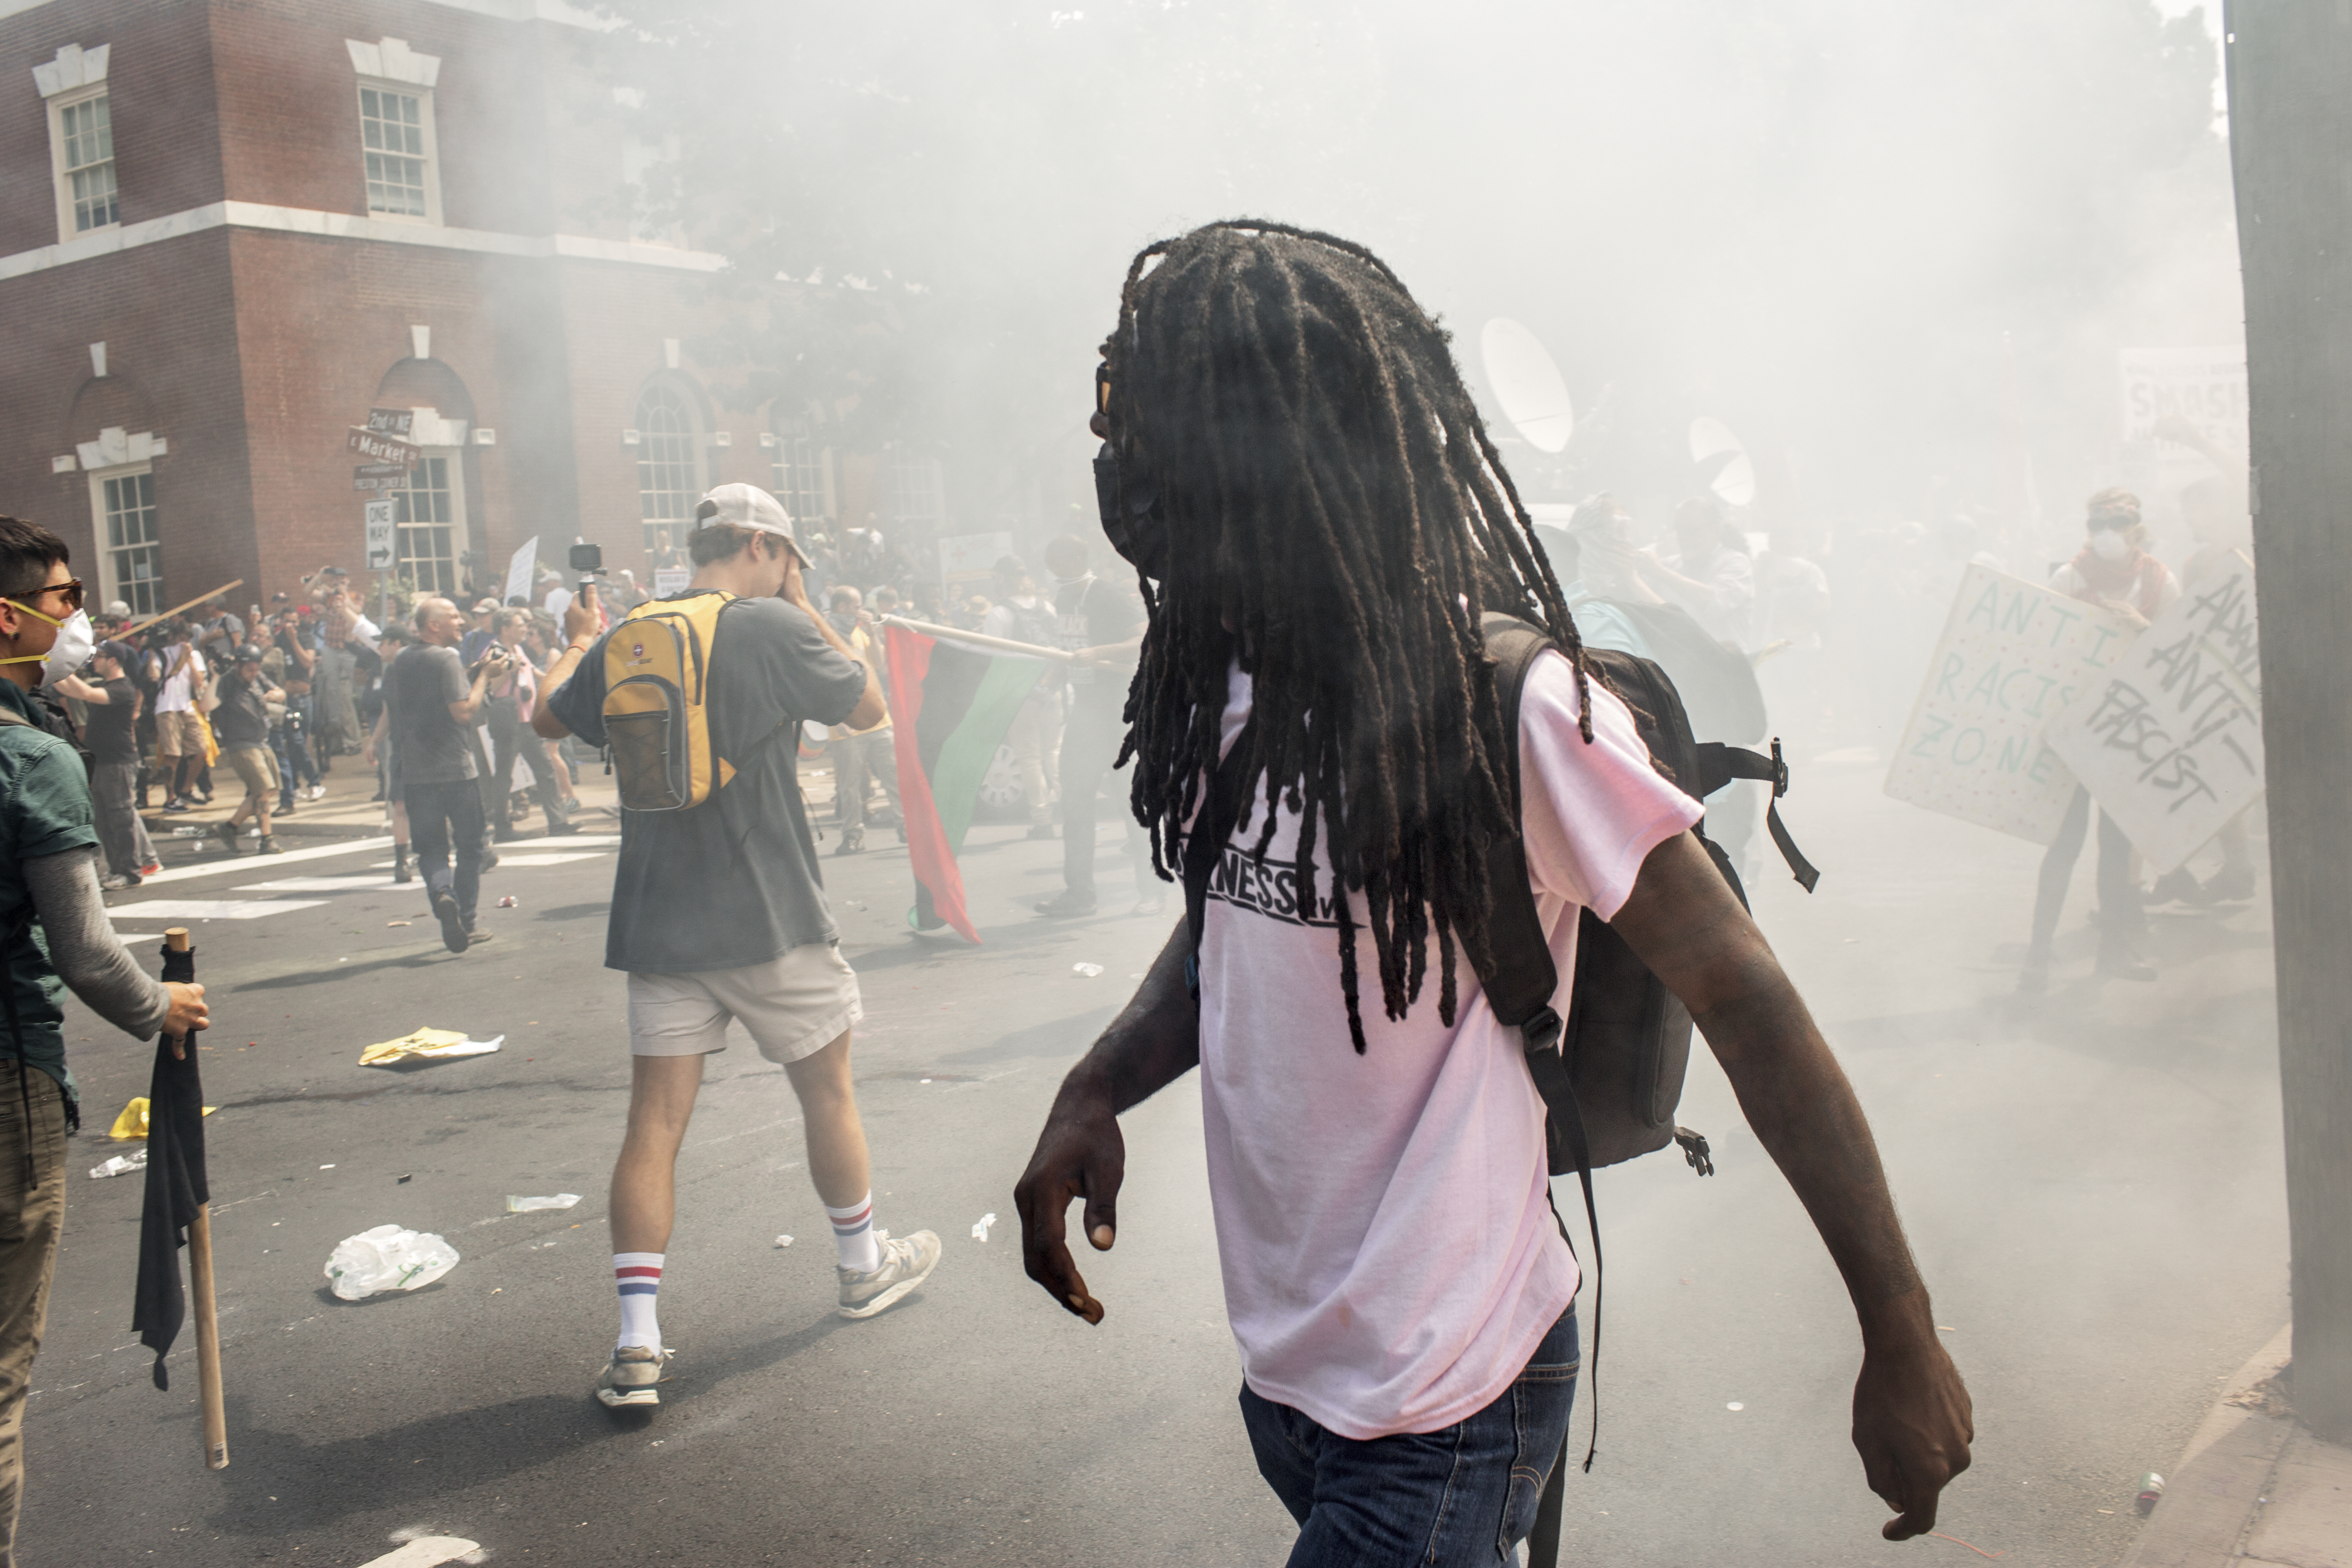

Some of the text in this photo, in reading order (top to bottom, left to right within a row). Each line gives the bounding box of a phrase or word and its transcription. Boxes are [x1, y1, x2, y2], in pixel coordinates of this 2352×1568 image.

[369, 413, 388, 429] 2nd
[396, 414, 410, 432] NE
[359, 436, 406, 462] Market
[369, 505, 389, 522] ONE
[369, 526, 389, 541] WAY
[1966, 581, 2117, 668] ANTI
[1936, 652, 2075, 719] RACIS
[1910, 714, 2053, 784] ZONE
[1207, 850, 1297, 915] NESS
